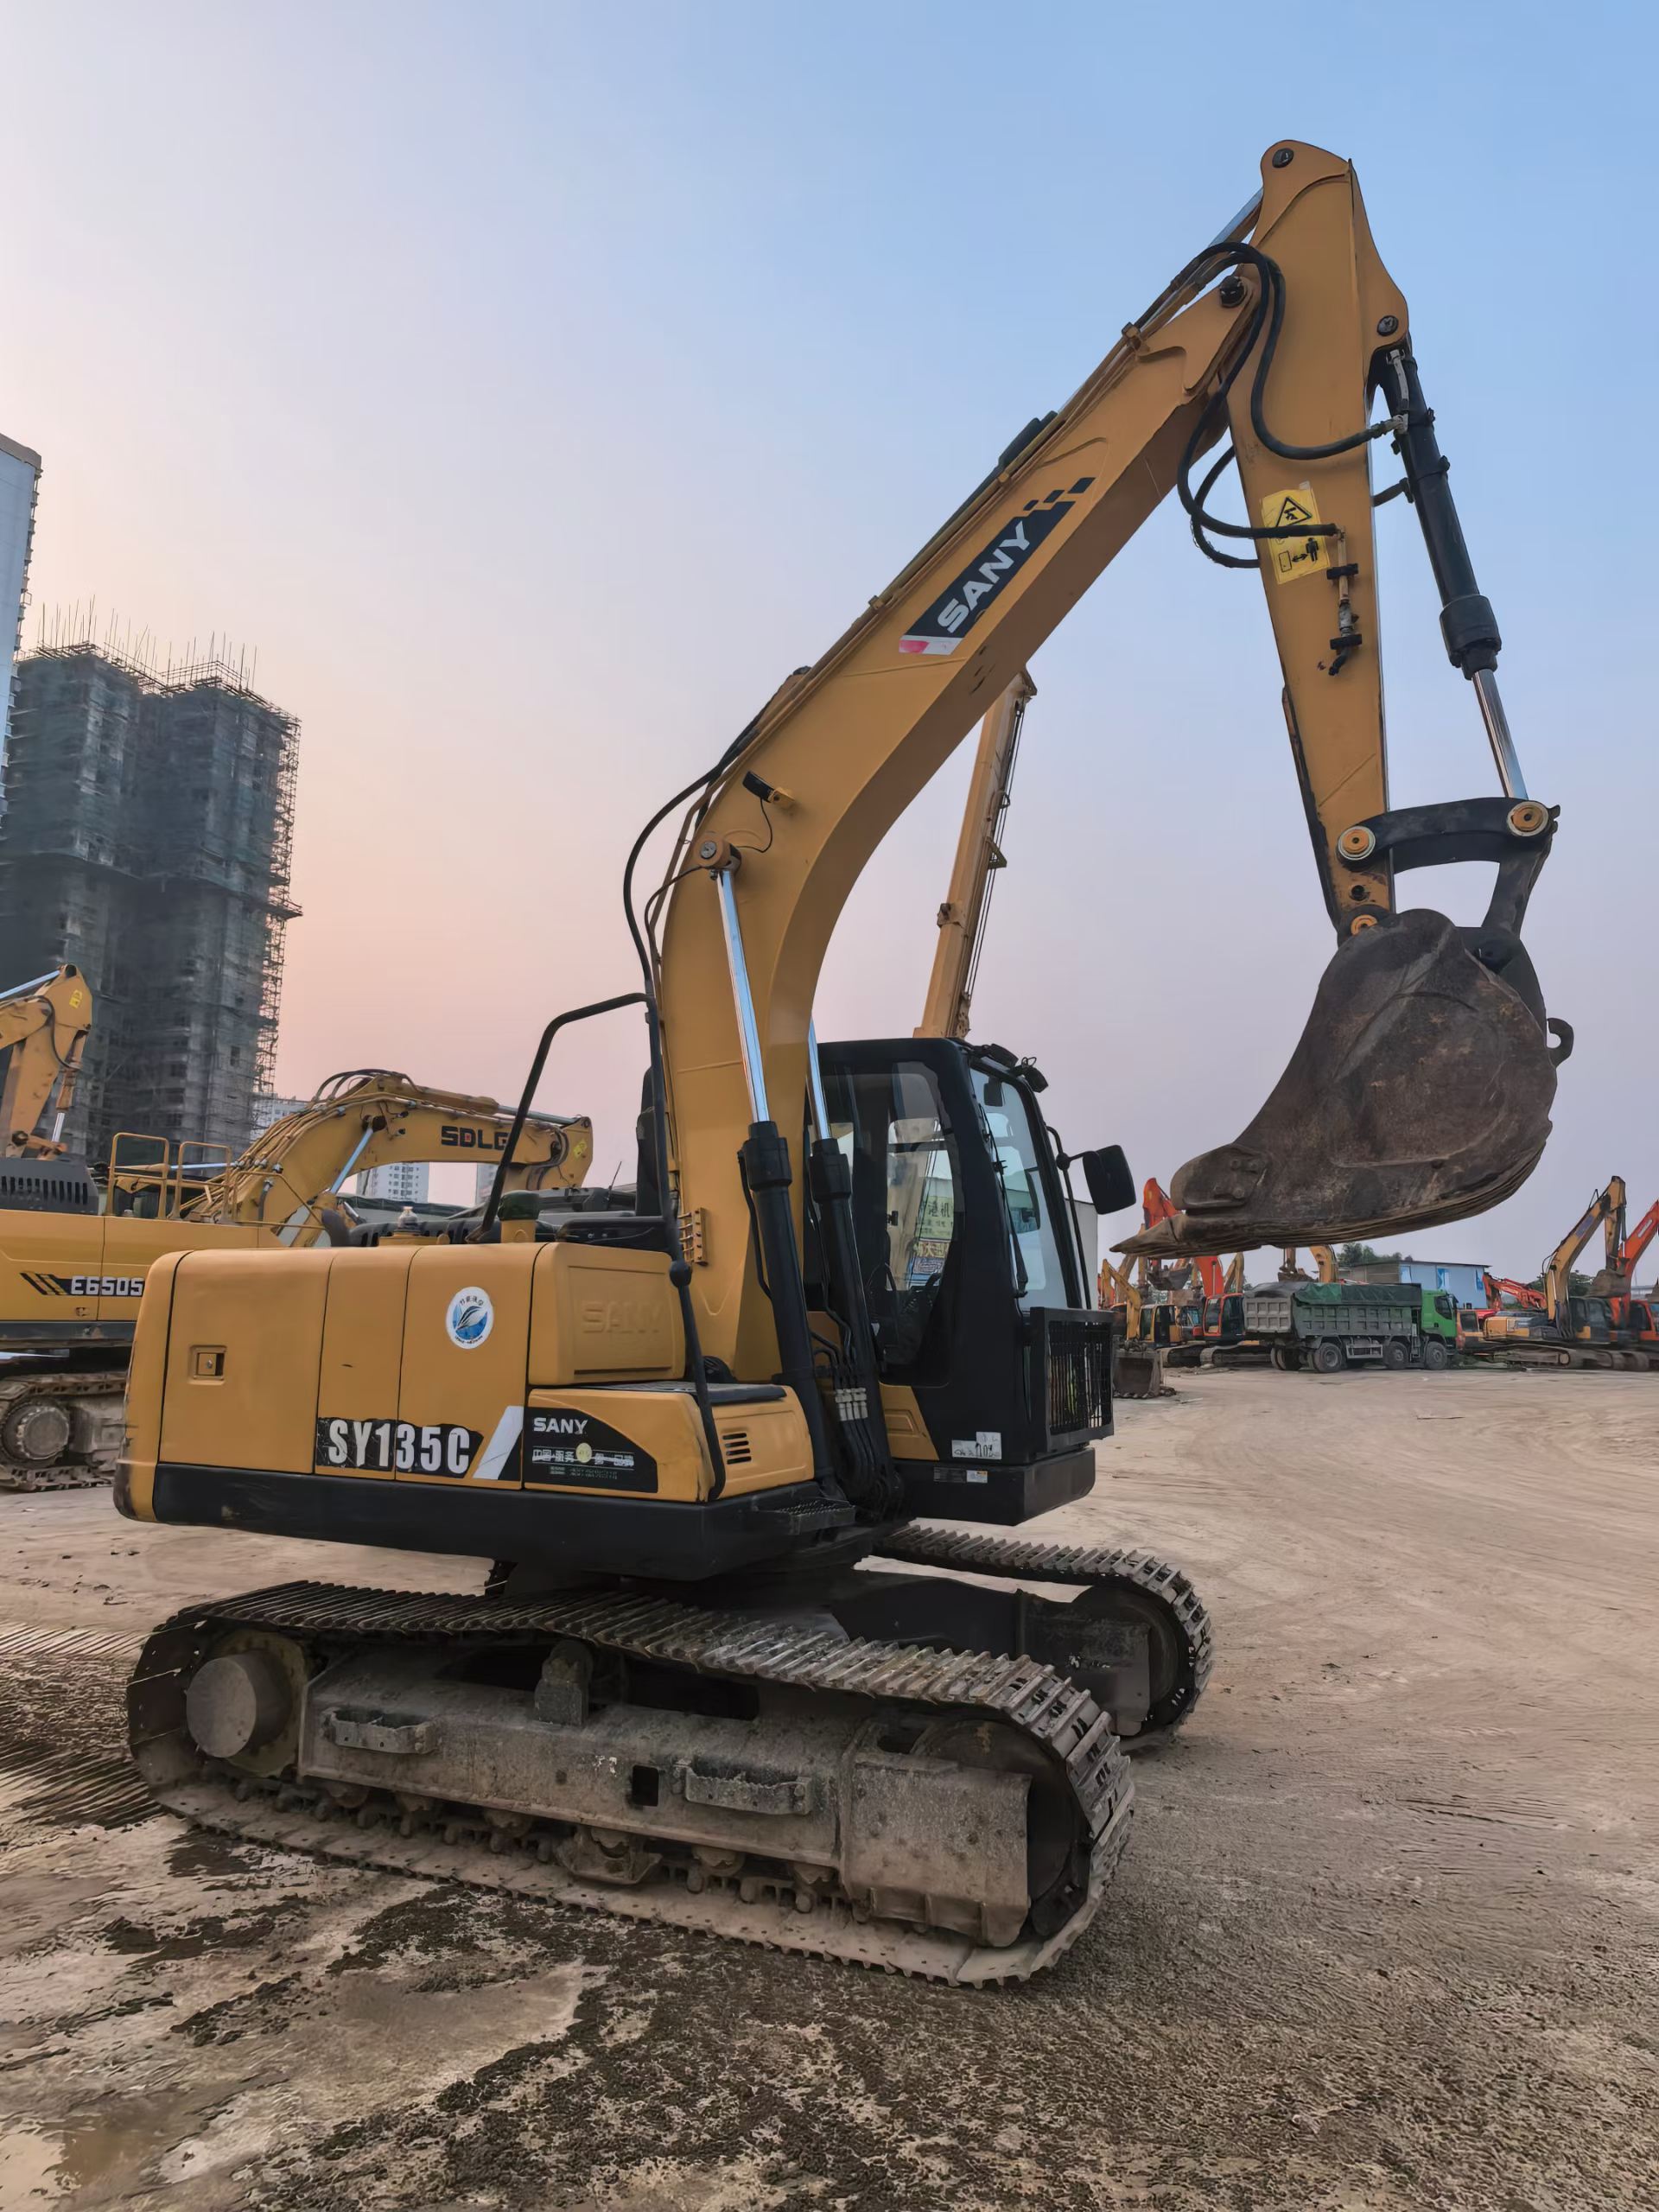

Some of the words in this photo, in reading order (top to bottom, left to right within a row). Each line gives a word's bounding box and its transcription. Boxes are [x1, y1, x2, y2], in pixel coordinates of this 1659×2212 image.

[938, 520, 1030, 633] SANY
[441, 1125, 512, 1151] SDLG
[533, 1416, 588, 1435] SANY
[327, 1419, 471, 1474] SY135C
